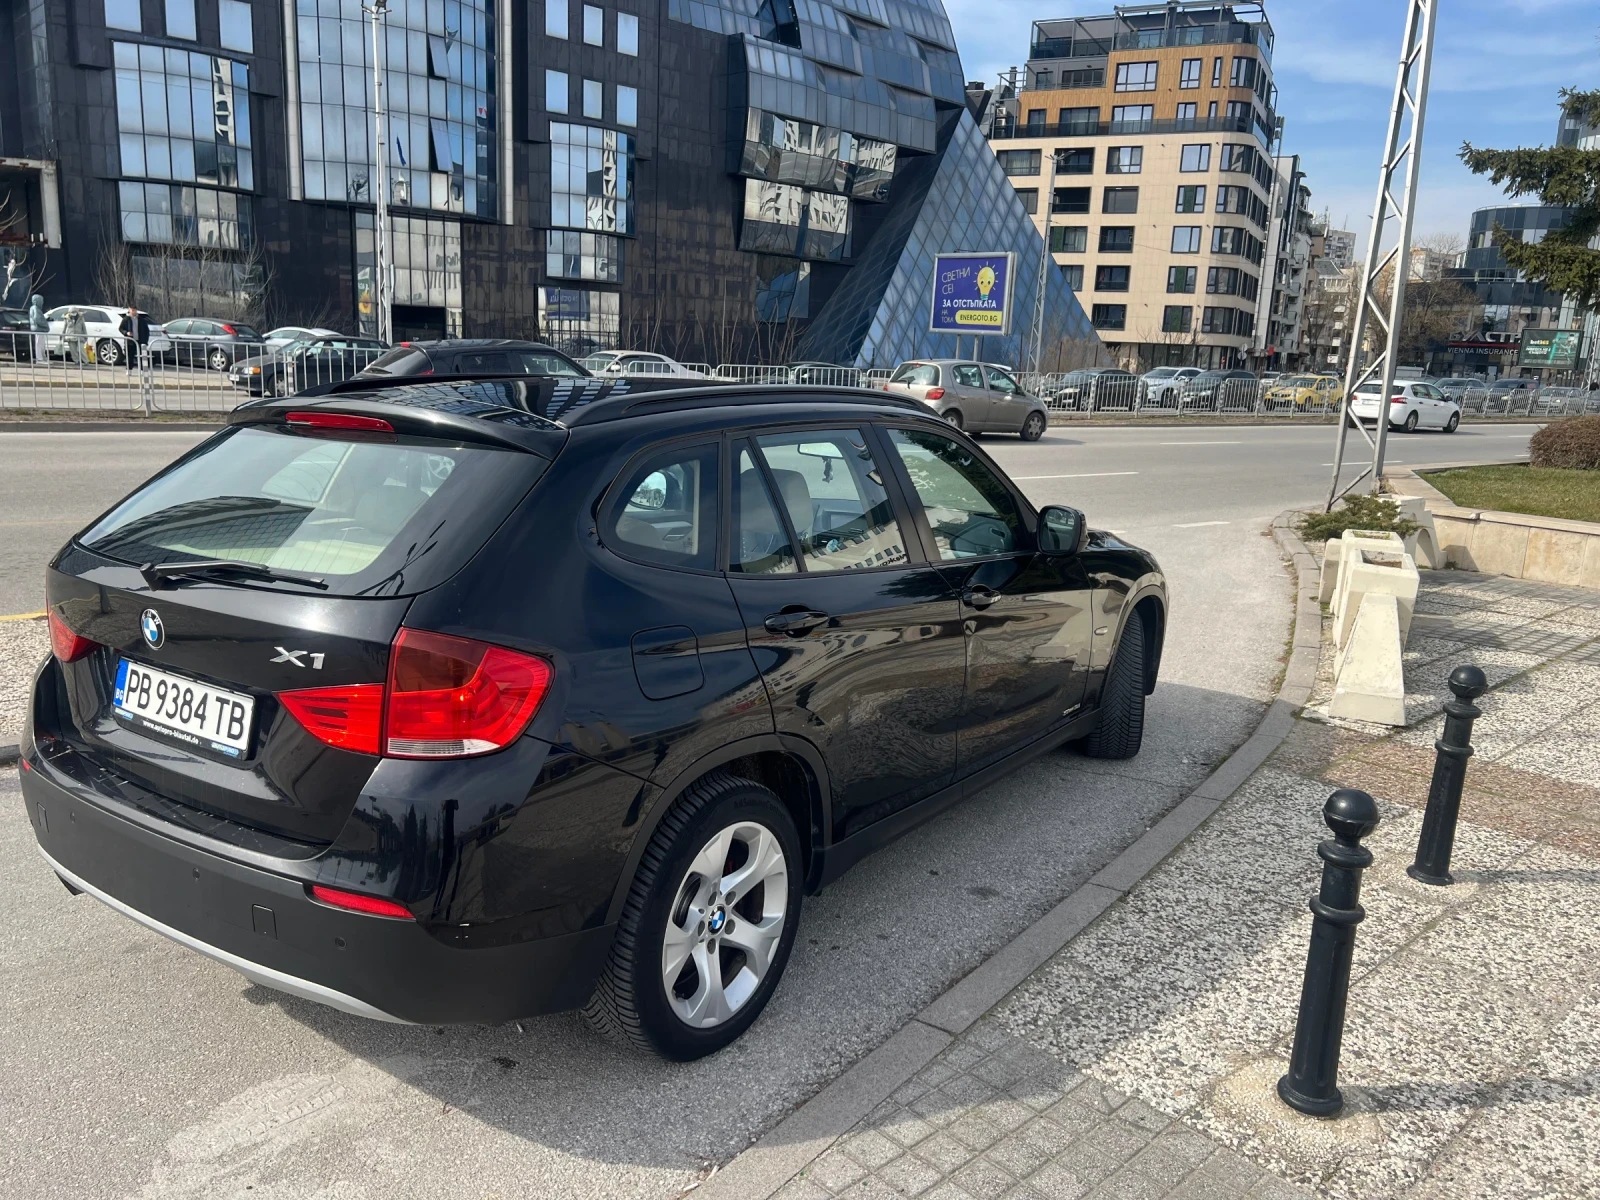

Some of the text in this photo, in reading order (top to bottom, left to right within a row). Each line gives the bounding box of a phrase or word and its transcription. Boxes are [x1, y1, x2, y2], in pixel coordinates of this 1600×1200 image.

[942, 267, 970, 282] СВЕТНИ
[942, 299, 997, 309] ЗА ОТСТЪПКАТА
[960, 314, 998, 323] ENERGOTO.BG
[1475, 348, 1519, 356] INSURANCE
[269, 646, 325, 670] X1
[115, 688, 124, 701] BG
[125, 668, 246, 741] PB 9384 TB
